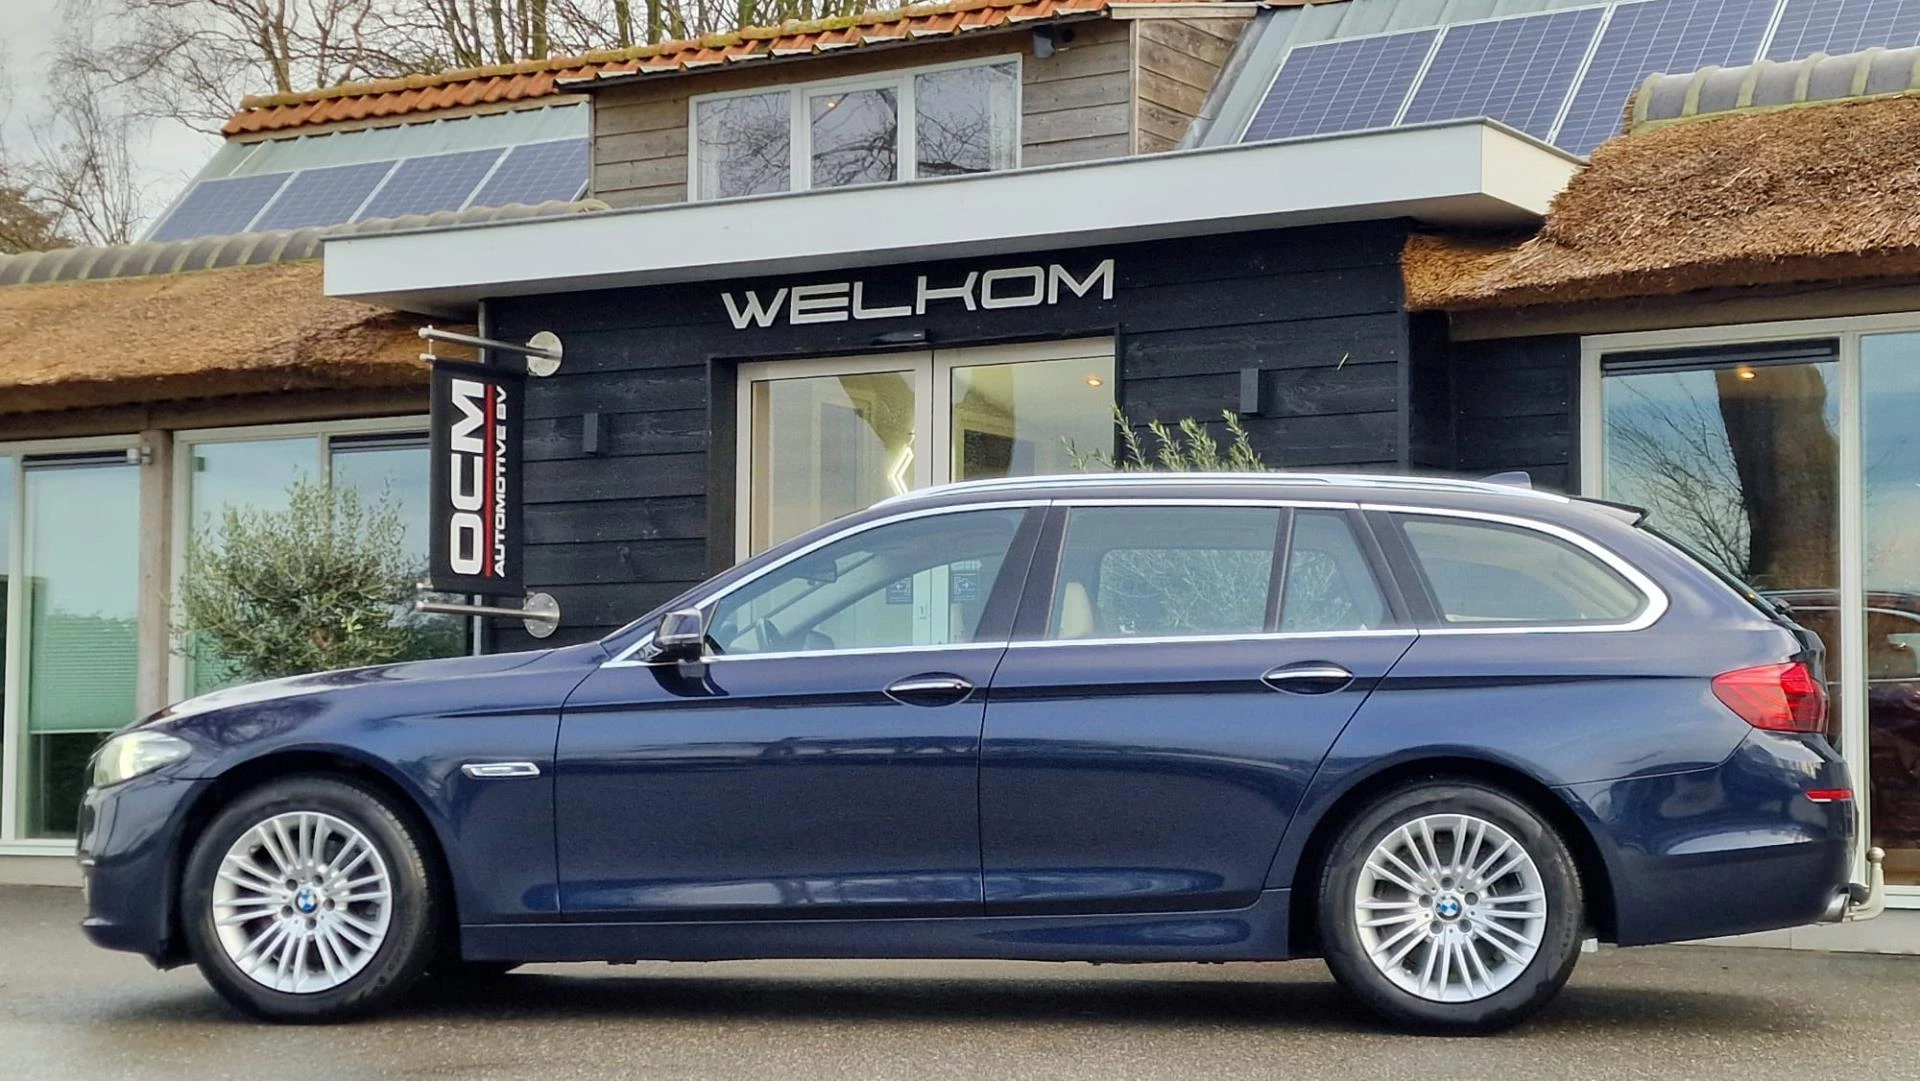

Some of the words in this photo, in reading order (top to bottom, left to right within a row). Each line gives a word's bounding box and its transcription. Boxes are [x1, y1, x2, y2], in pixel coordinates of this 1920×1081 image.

[720, 258, 1115, 330] WELKOM
[496, 385, 508, 420] BV
[450, 378, 485, 575] OCM
[494, 424, 507, 578] AUTOMOTIVE
